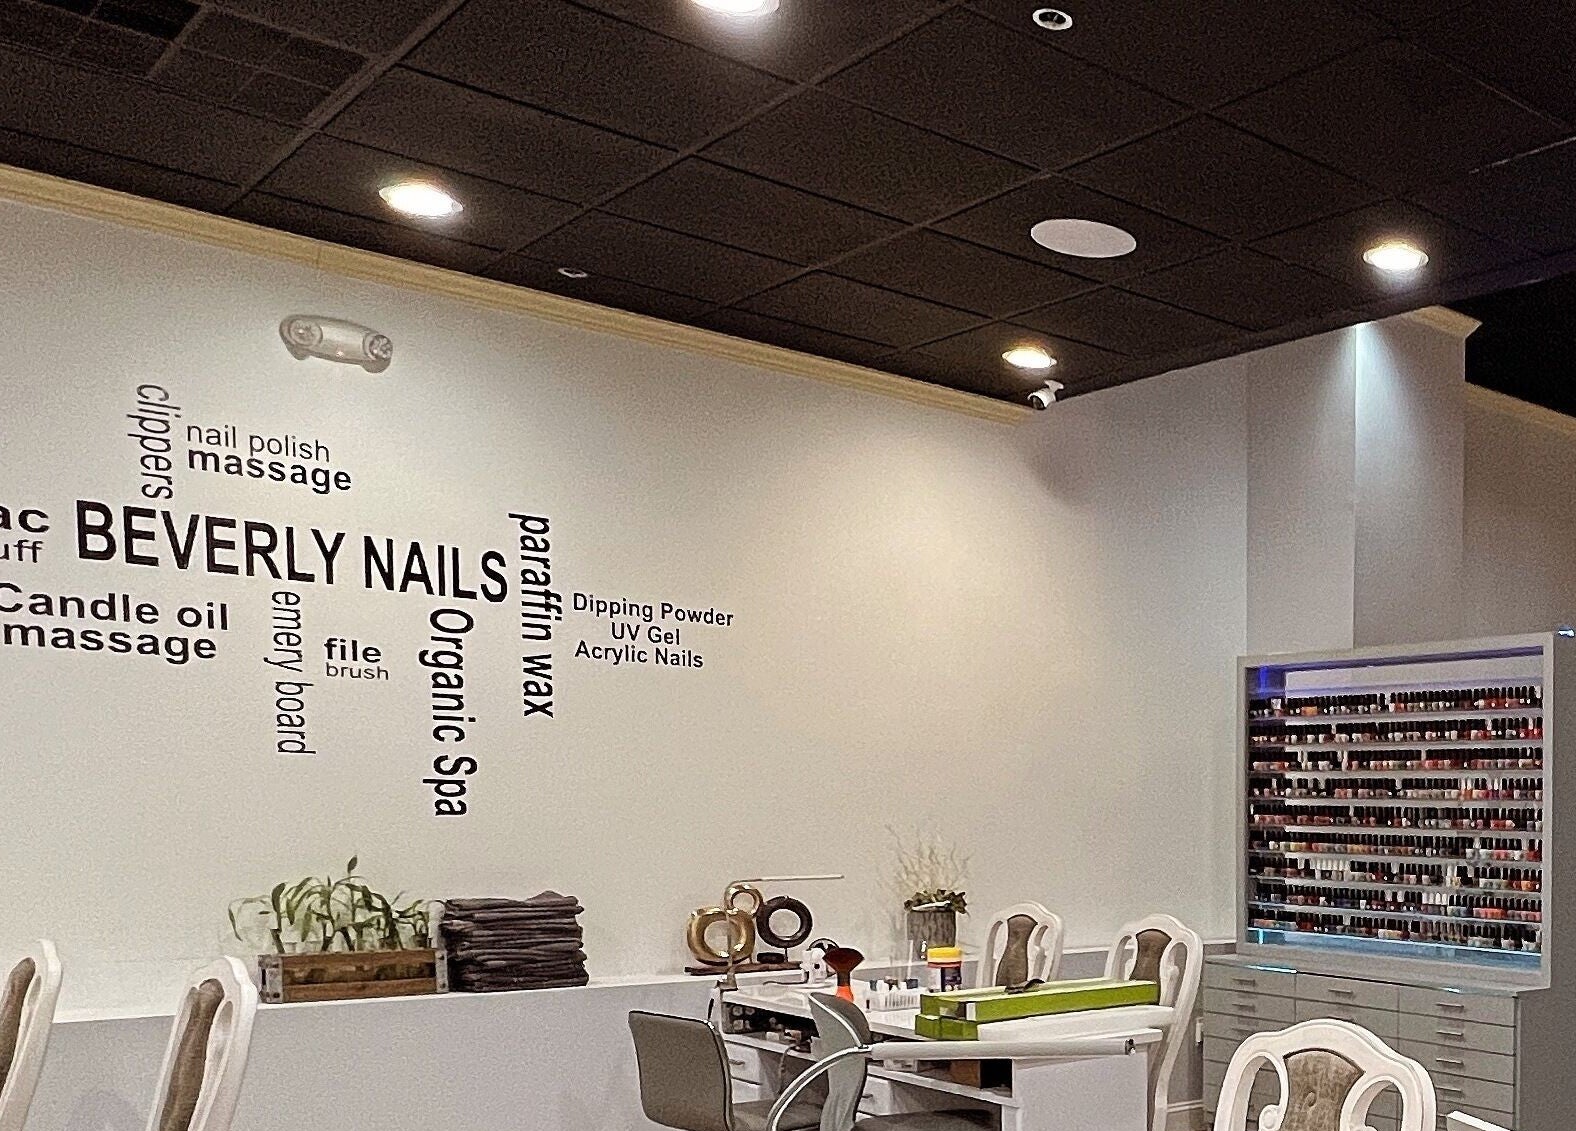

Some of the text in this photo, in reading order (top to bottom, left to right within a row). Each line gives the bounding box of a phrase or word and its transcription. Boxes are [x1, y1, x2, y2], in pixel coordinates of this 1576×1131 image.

[125, 384, 182, 500] clippers
[186, 425, 330, 463] nail polish
[188, 448, 352, 495] massage
[76, 499, 508, 603] BEVERLY NAILS
[0, 582, 228, 631] Candle oil
[507, 512, 563, 719] paraffin wax
[573, 592, 734, 627] Dipping Powder
[3, 623, 217, 665] massage
[323, 637, 382, 664] file
[574, 639, 704, 669] Acrylic Nails
[611, 621, 680, 646] UV Gel
[262, 590, 317, 755] emery board
[325, 661, 389, 681] brush
[418, 608, 478, 817] Organic Spa
